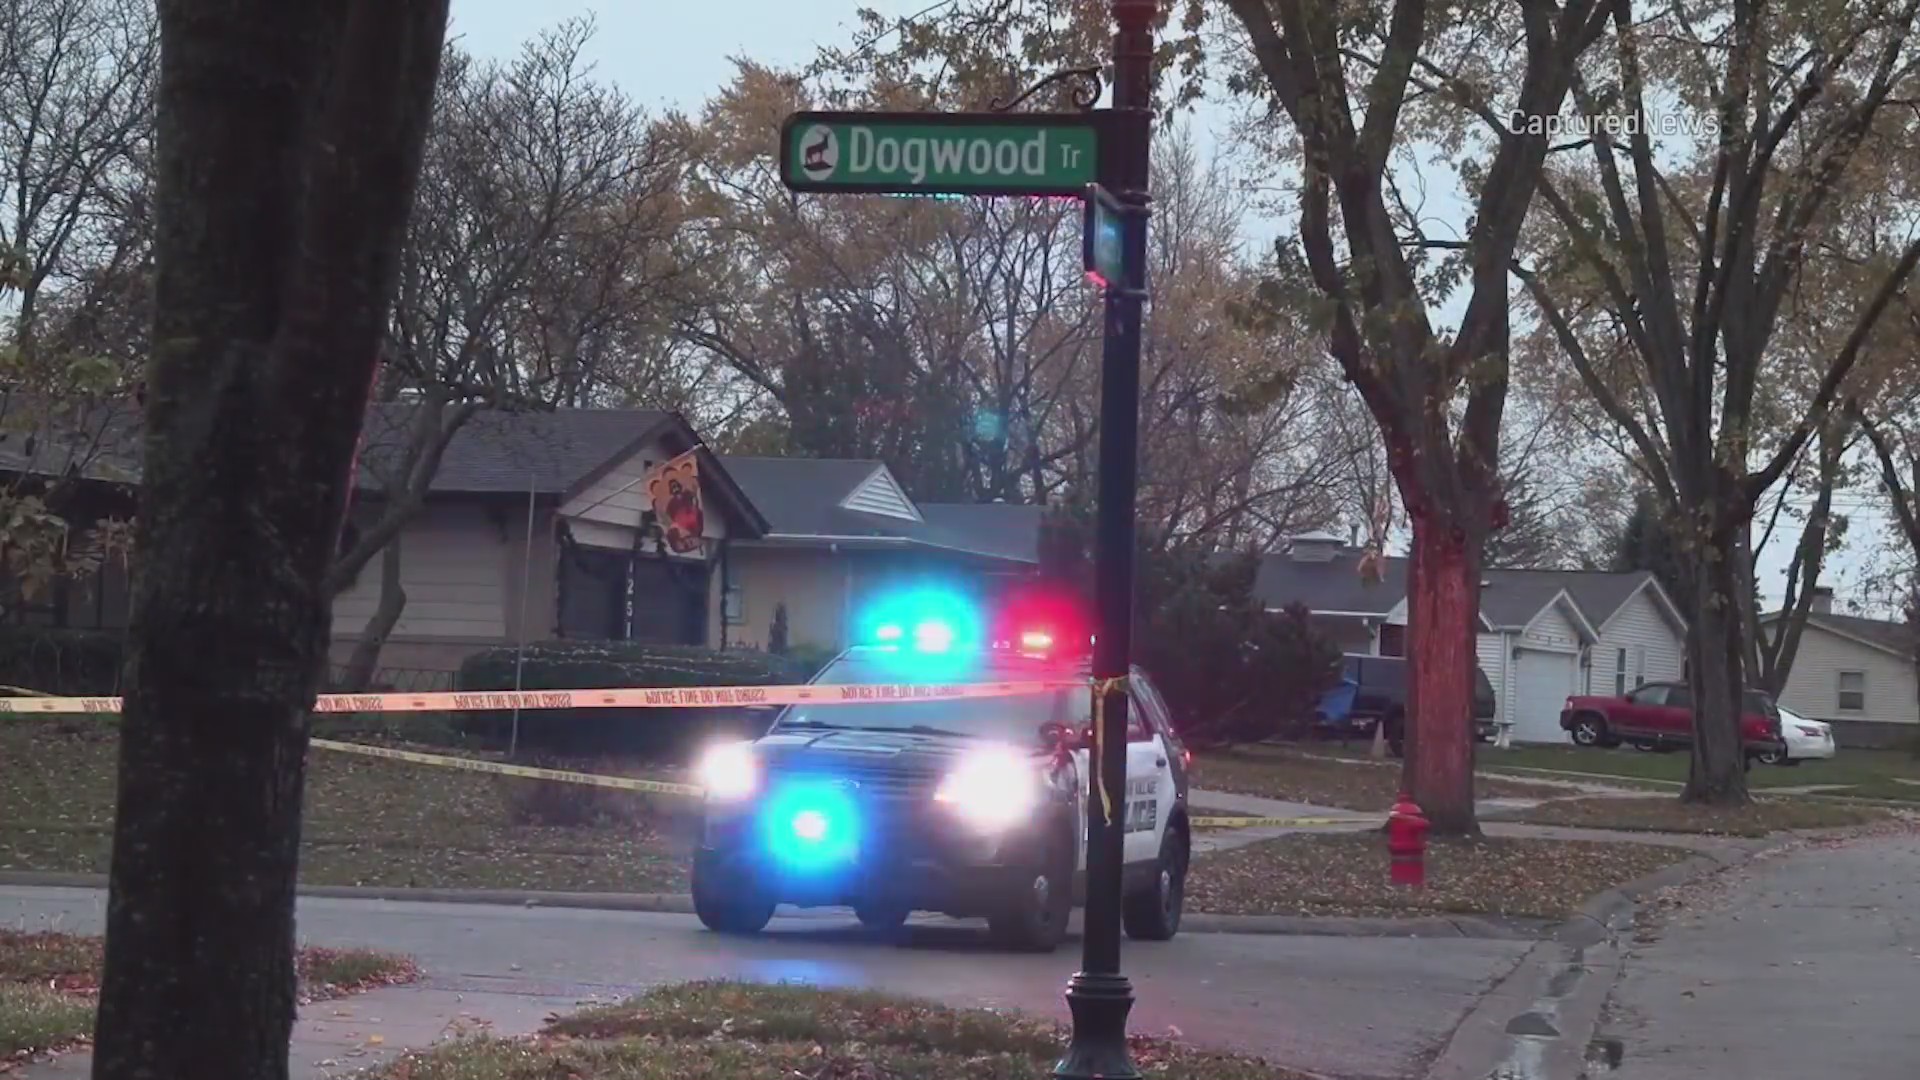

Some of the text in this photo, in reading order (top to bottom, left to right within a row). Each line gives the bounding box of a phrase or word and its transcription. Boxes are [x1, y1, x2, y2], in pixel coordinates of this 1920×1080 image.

[849, 125, 1081, 184] Dogwood Tr
[625, 558, 635, 638] 1251
[1122, 799, 1157, 833] LICE
